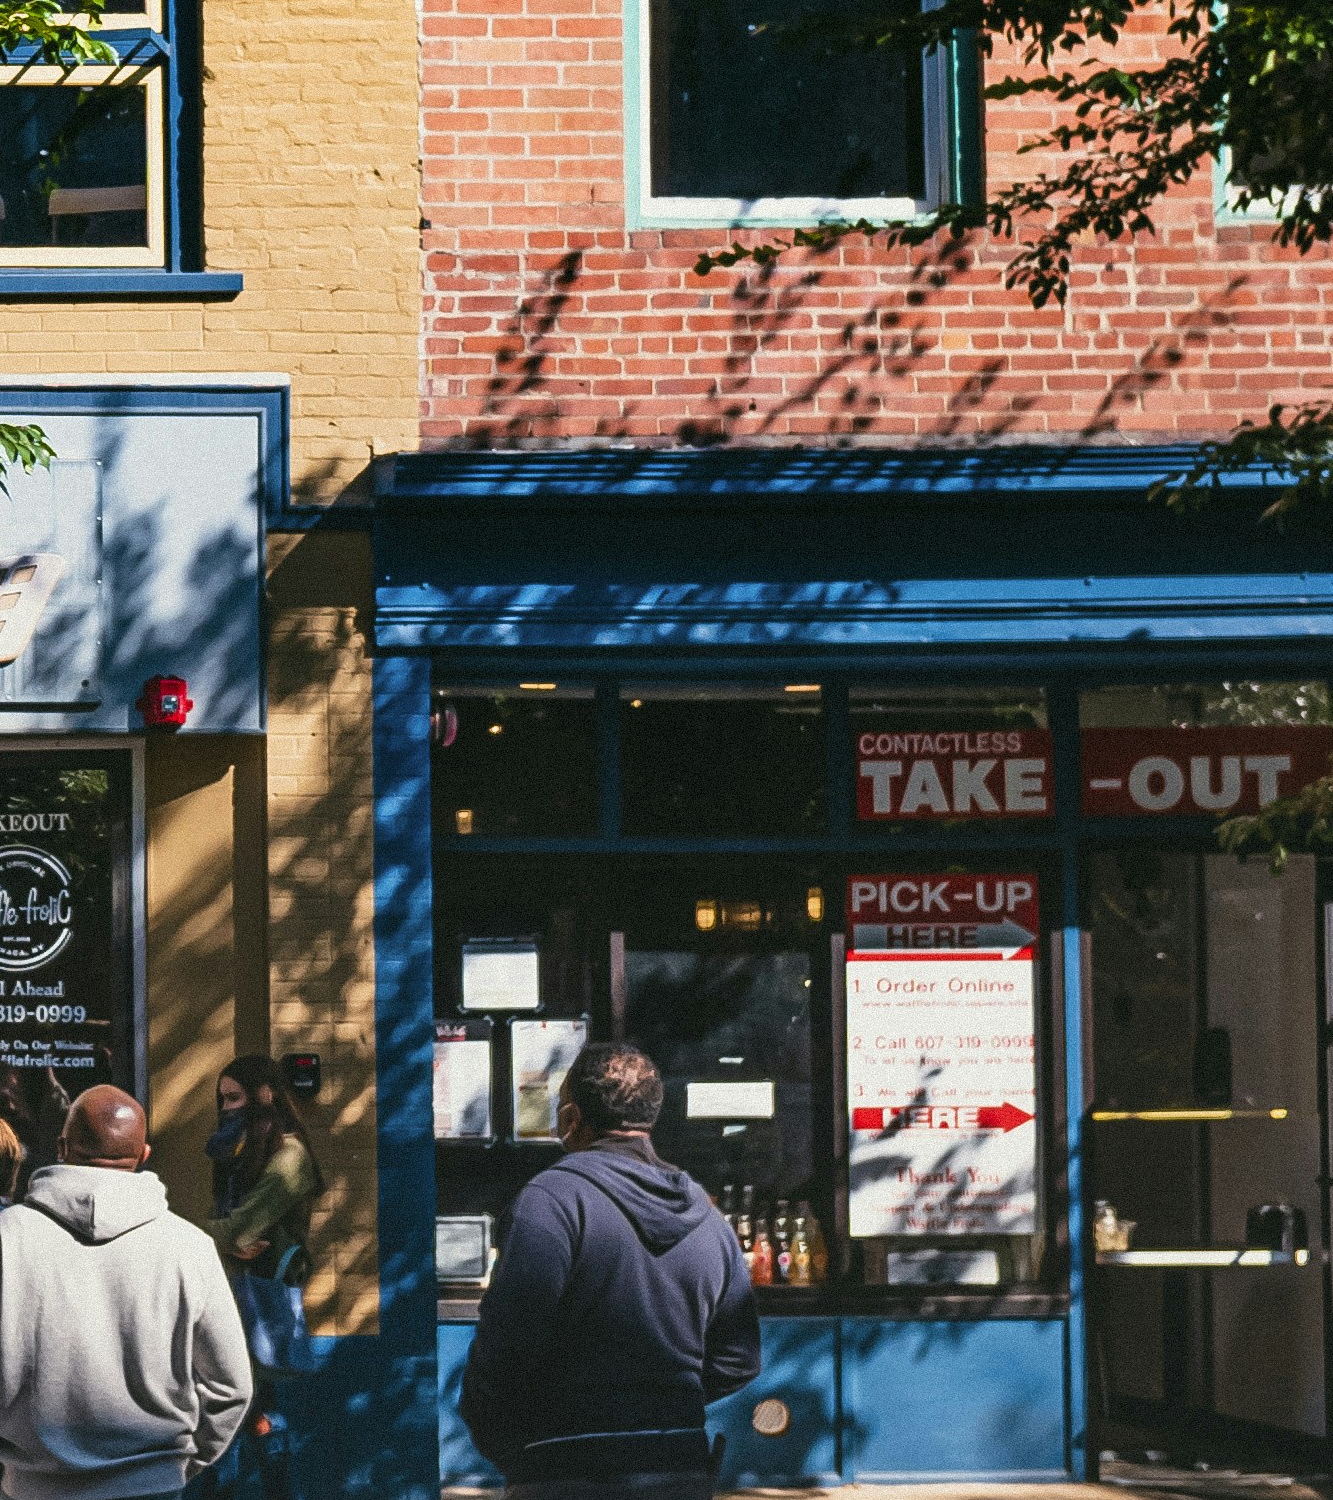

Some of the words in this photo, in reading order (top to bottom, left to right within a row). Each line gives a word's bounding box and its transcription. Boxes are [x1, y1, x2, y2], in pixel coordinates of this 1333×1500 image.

[859, 732, 1022, 755] CONTACTLESS
[860, 758, 1047, 814] TAKE
[851, 880, 1033, 913] PICK-UP
[887, 926, 978, 949] HERE
[11, 980, 64, 996] Ahead
[876, 978, 936, 993] Order
[948, 978, 1015, 993] Online
